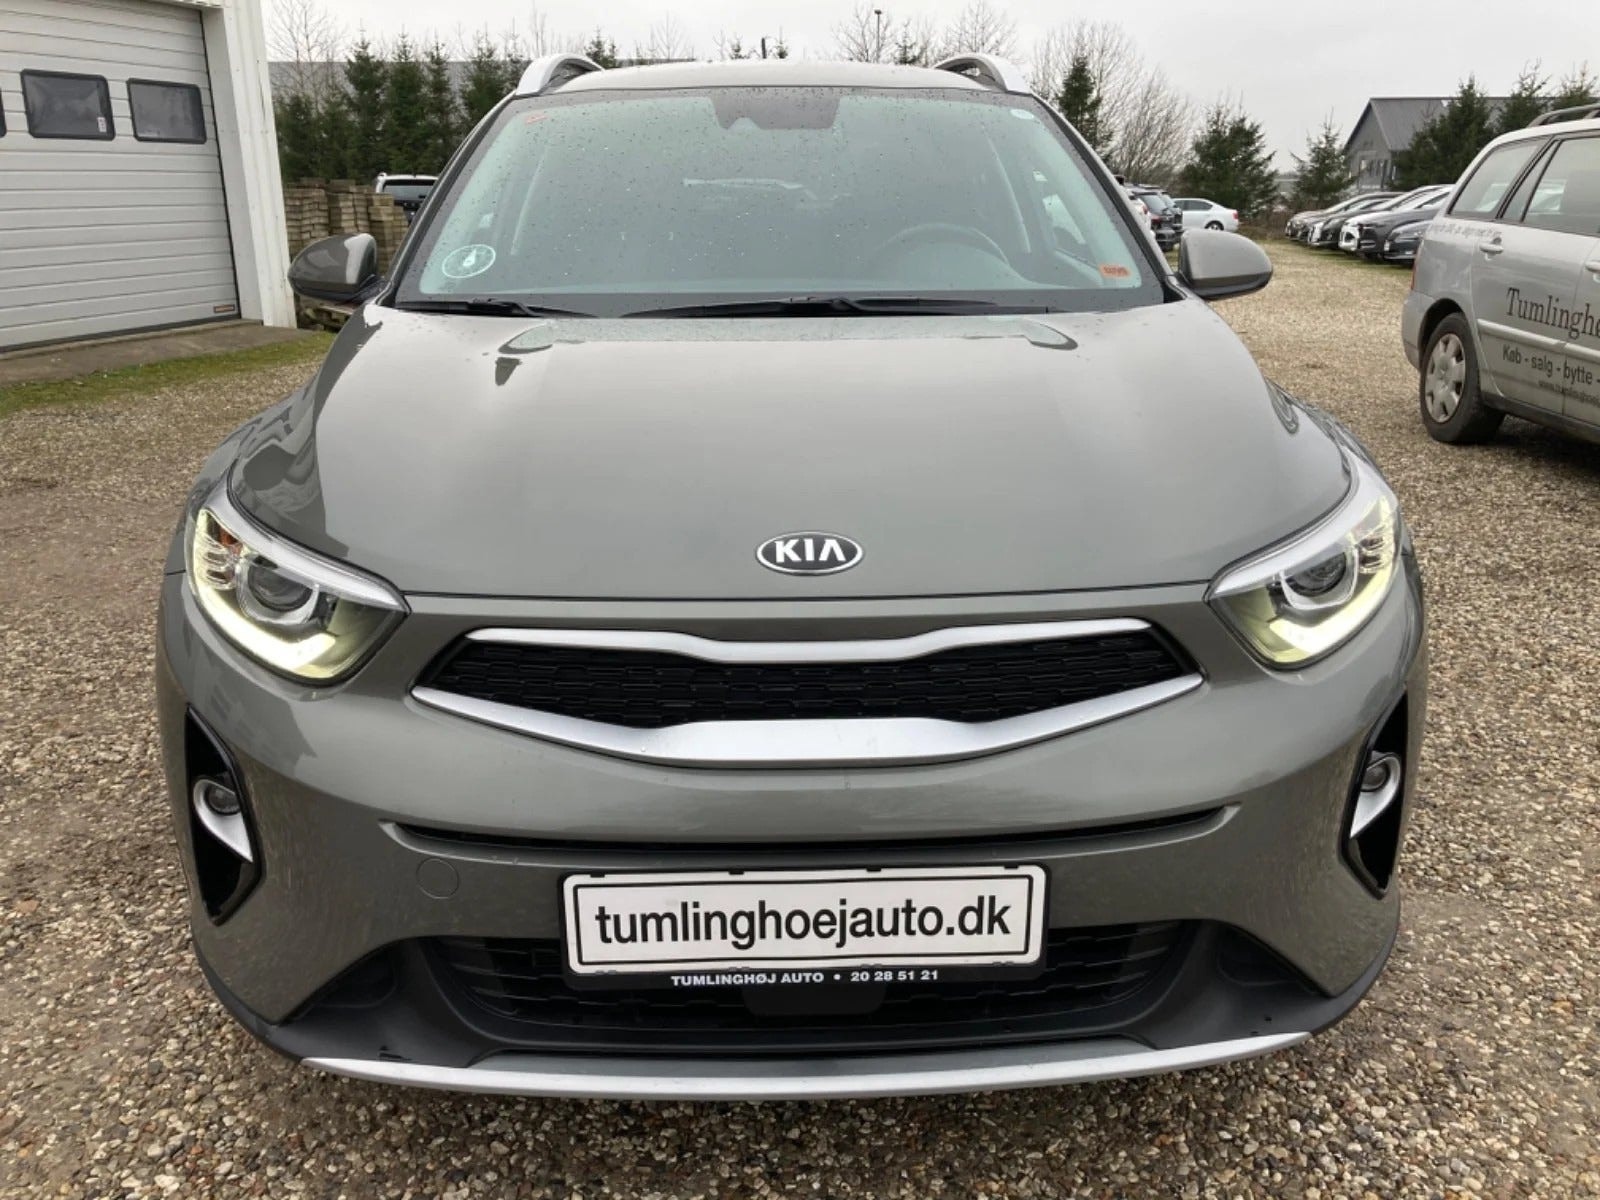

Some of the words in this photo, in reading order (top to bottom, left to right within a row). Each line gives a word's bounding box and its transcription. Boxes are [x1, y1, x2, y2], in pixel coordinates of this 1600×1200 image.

[1506, 287, 1600, 340] Tumlingh
[1531, 354, 1553, 378] salg
[1563, 359, 1593, 385] bytte
[775, 538, 846, 563] KIA
[595, 896, 1011, 950] tumlinghoejauto.dk
[671, 973, 777, 986] TUMLINGHØJ
[780, 972, 825, 983] AUTO
[850, 971, 870, 982] 20
[874, 971, 893, 982] 28
[897, 970, 915, 981] 51
[920, 969, 938, 980] 21
